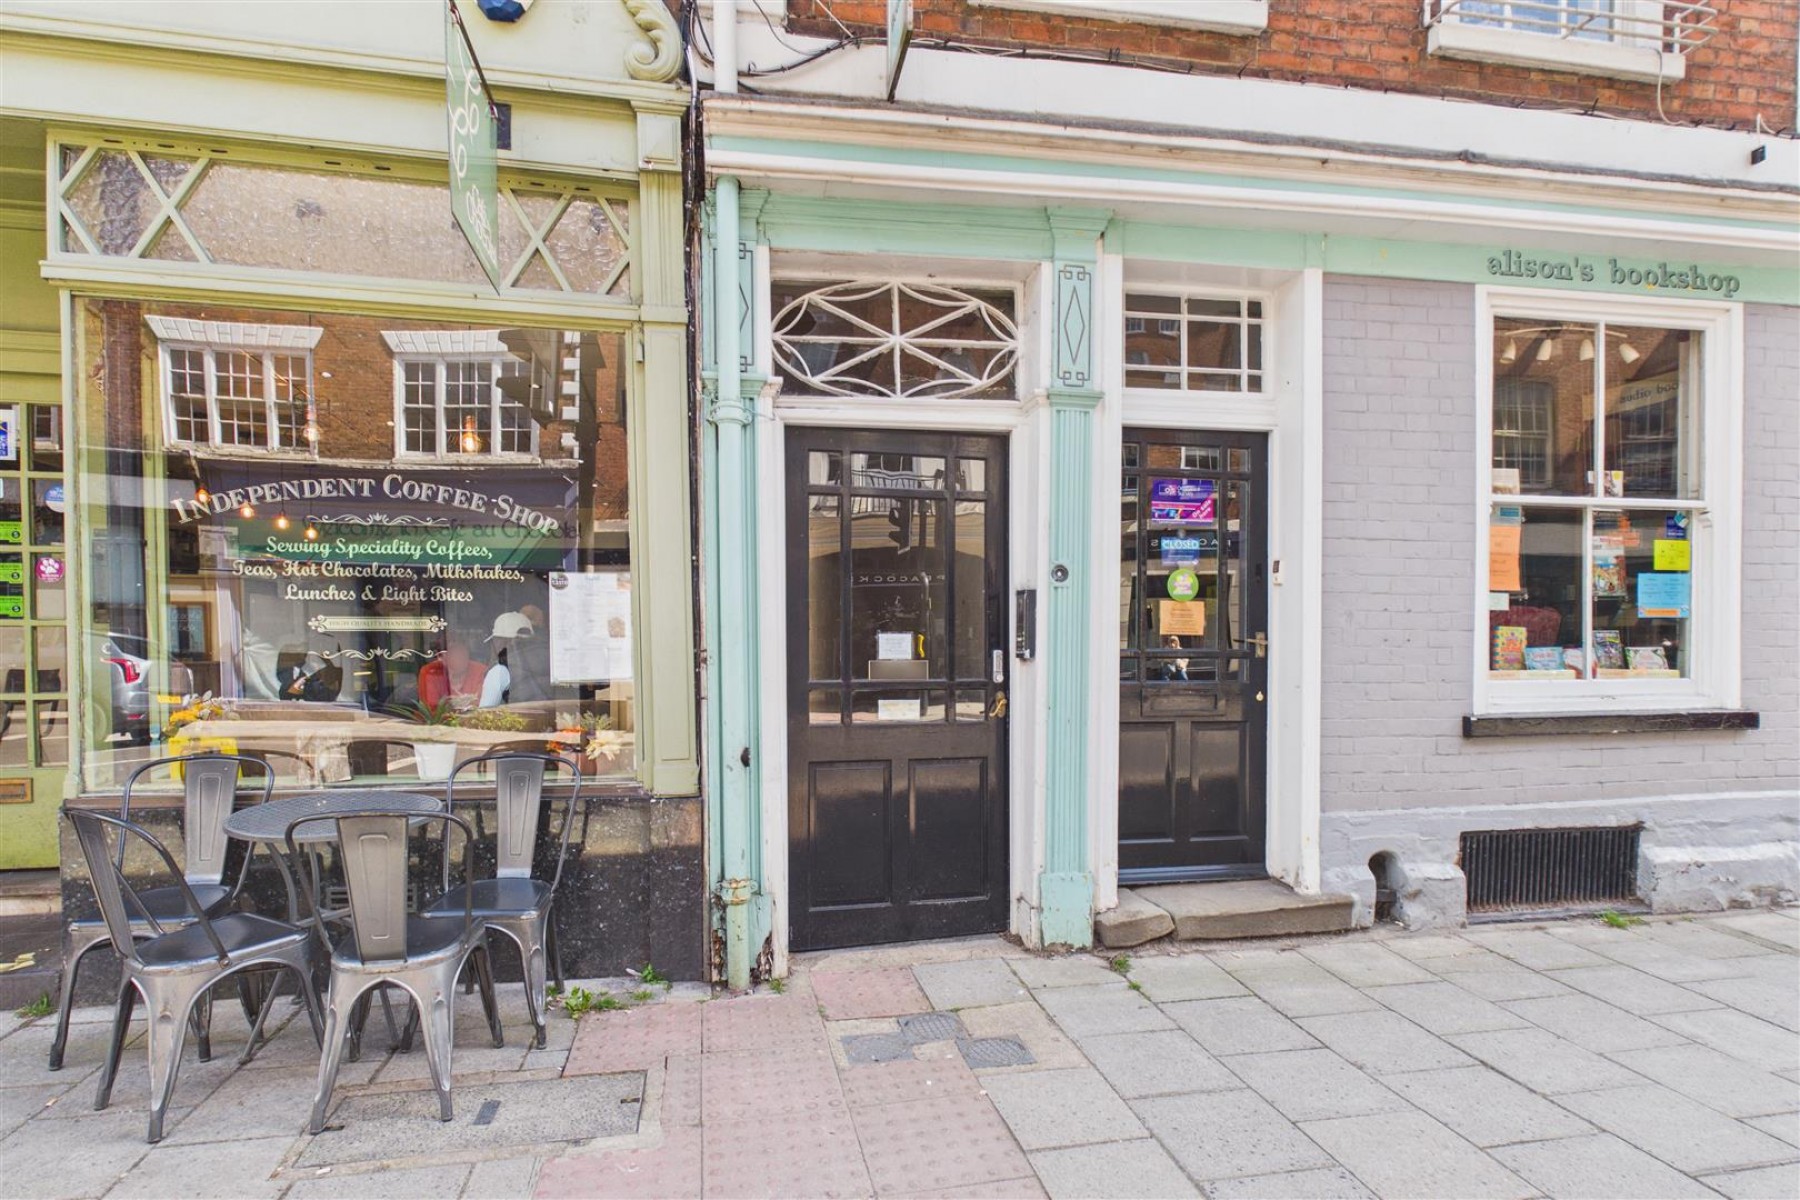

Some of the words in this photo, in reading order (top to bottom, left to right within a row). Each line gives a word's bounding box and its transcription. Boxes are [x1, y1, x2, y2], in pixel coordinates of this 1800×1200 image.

[1487, 249, 1594, 282] alison's
[1608, 258, 1740, 298] bookshop
[1656, 382, 1679, 394] boo
[266, 535, 332, 559] Serving
[336, 537, 424, 560] Speciality
[426, 539, 493, 560] Coffees,
[232, 559, 278, 579] Teas,
[282, 559, 319, 577] Hot
[321, 561, 418, 581] Chocolates,
[422, 562, 525, 583] Milkshakes,
[284, 583, 357, 601] Lunches
[361, 585, 377, 600] &
[381, 585, 428, 606] Light
[430, 585, 474, 602] Bites
